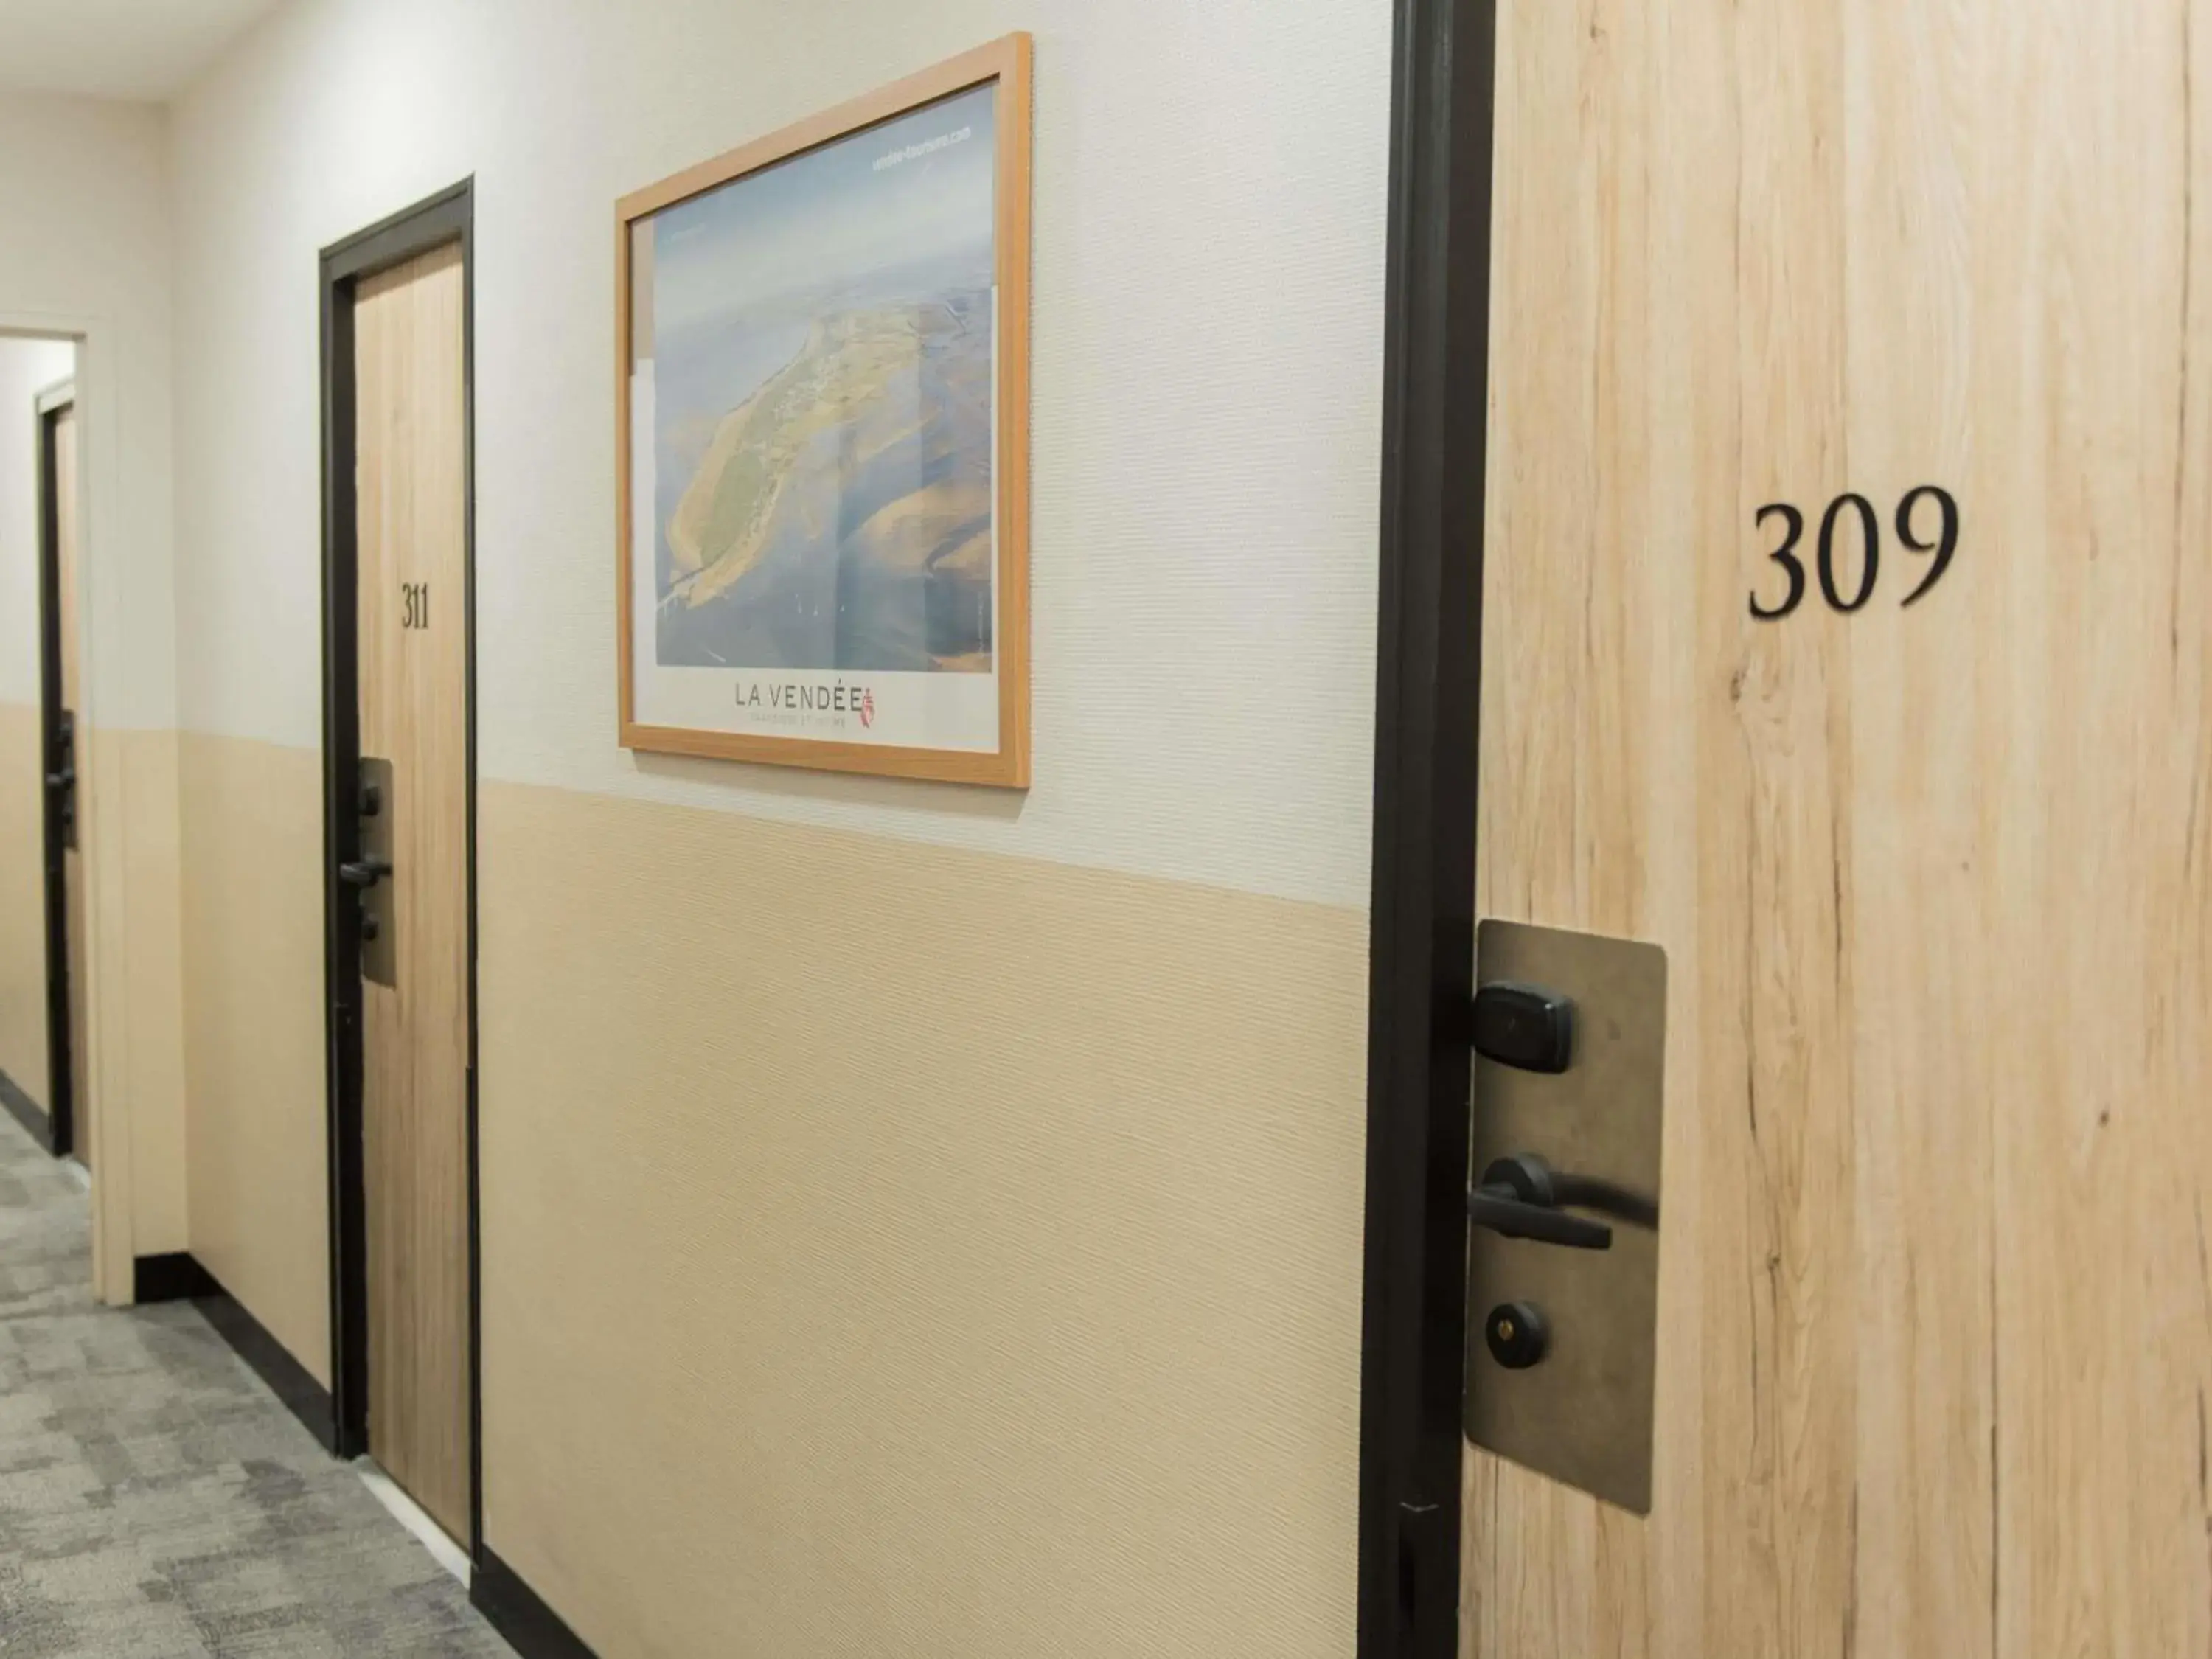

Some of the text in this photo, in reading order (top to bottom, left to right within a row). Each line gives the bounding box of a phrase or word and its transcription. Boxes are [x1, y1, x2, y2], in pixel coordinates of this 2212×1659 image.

[1749, 485, 1959, 622] 309
[402, 582, 428, 629] 311
[735, 678, 862, 711] LA VENDÉE
